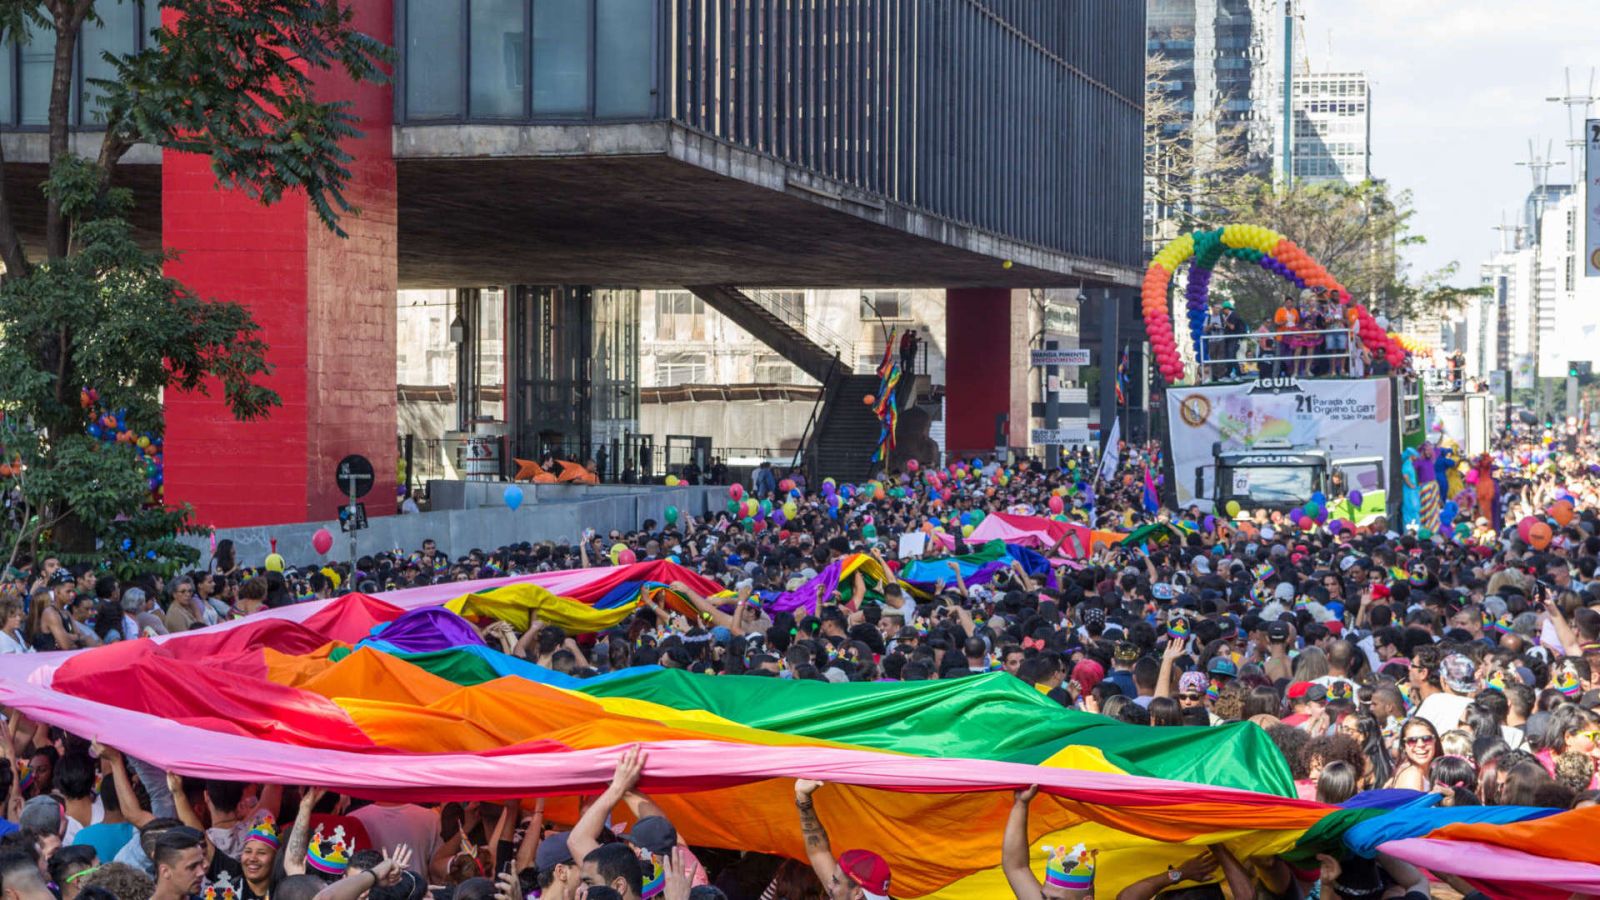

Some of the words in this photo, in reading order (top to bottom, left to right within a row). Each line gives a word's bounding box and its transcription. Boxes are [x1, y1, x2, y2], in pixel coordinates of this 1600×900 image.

[1313, 398, 1344, 406] Parada
[1313, 405, 1349, 415] Orgulho
[1351, 405, 1376, 413] LGBT
[1236, 455, 1305, 465] AGUIA
